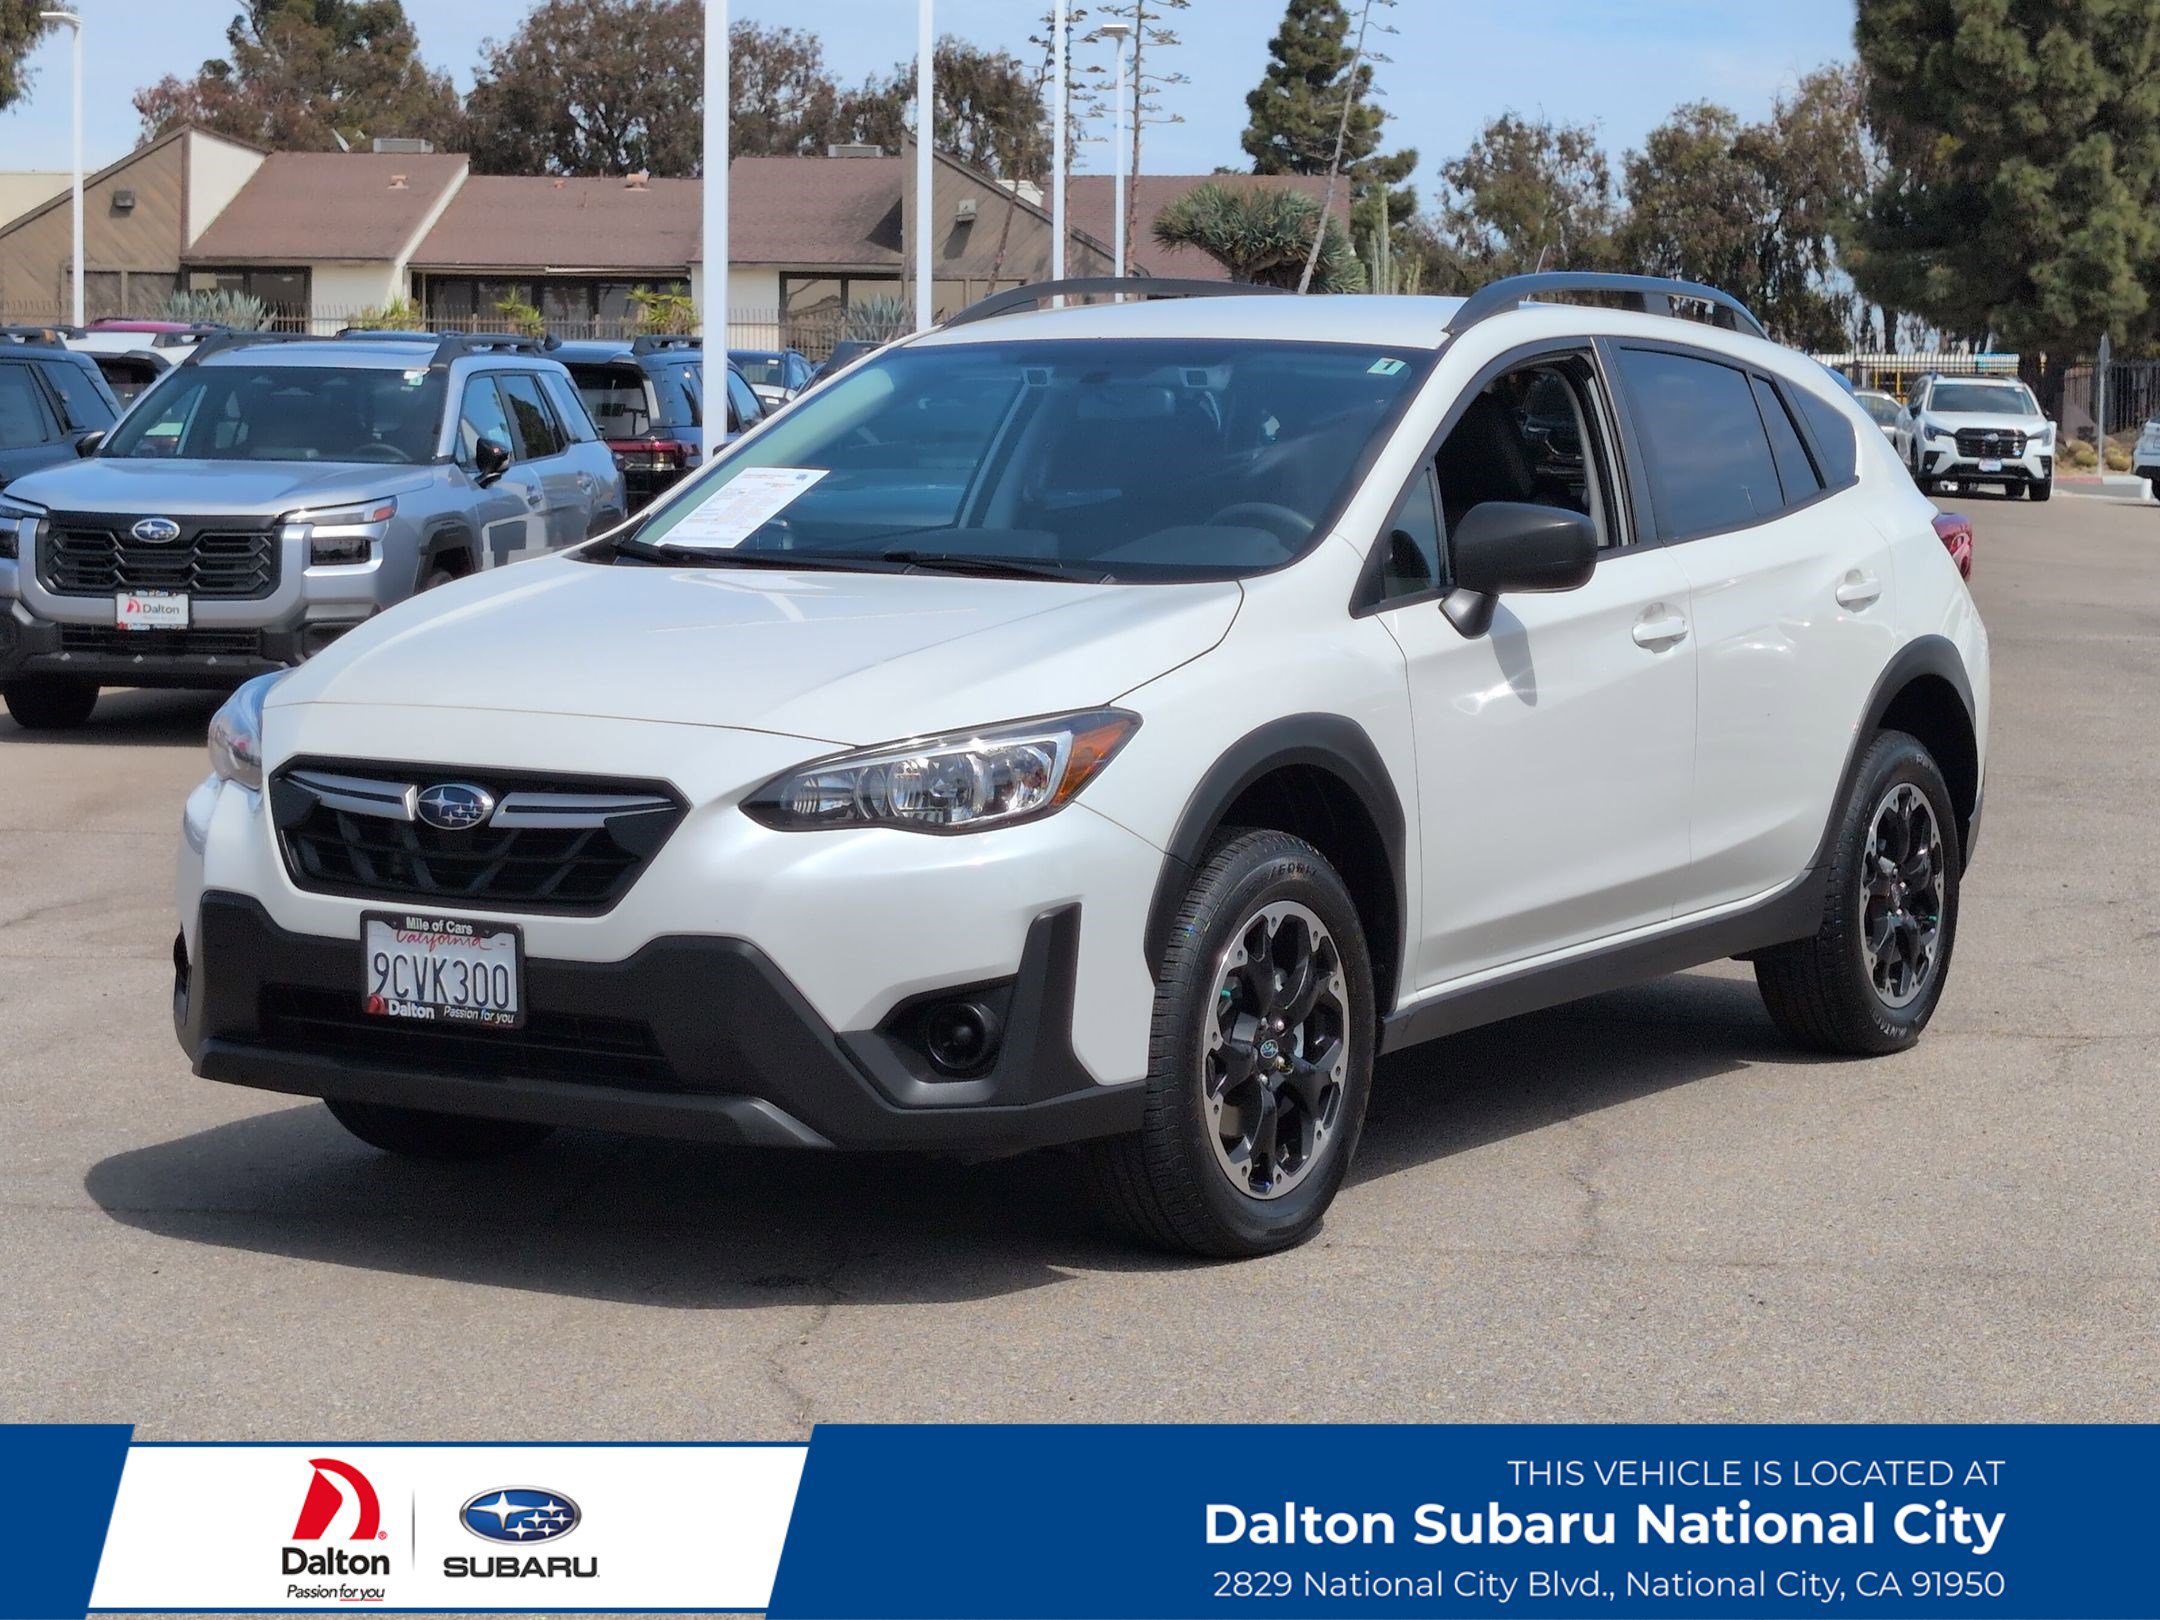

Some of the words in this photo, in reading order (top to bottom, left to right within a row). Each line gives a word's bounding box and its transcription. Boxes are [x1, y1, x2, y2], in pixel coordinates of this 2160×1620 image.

[143, 603, 180, 615] Dalton
[406, 916, 429, 931] Mile
[432, 920, 445, 932] of
[446, 922, 473, 935] Cars
[373, 951, 510, 1010] 9CVK300
[388, 999, 435, 1020] Dalton
[443, 1005, 479, 1020] Passion
[480, 1008, 495, 1021] for
[494, 1011, 515, 1025] you
